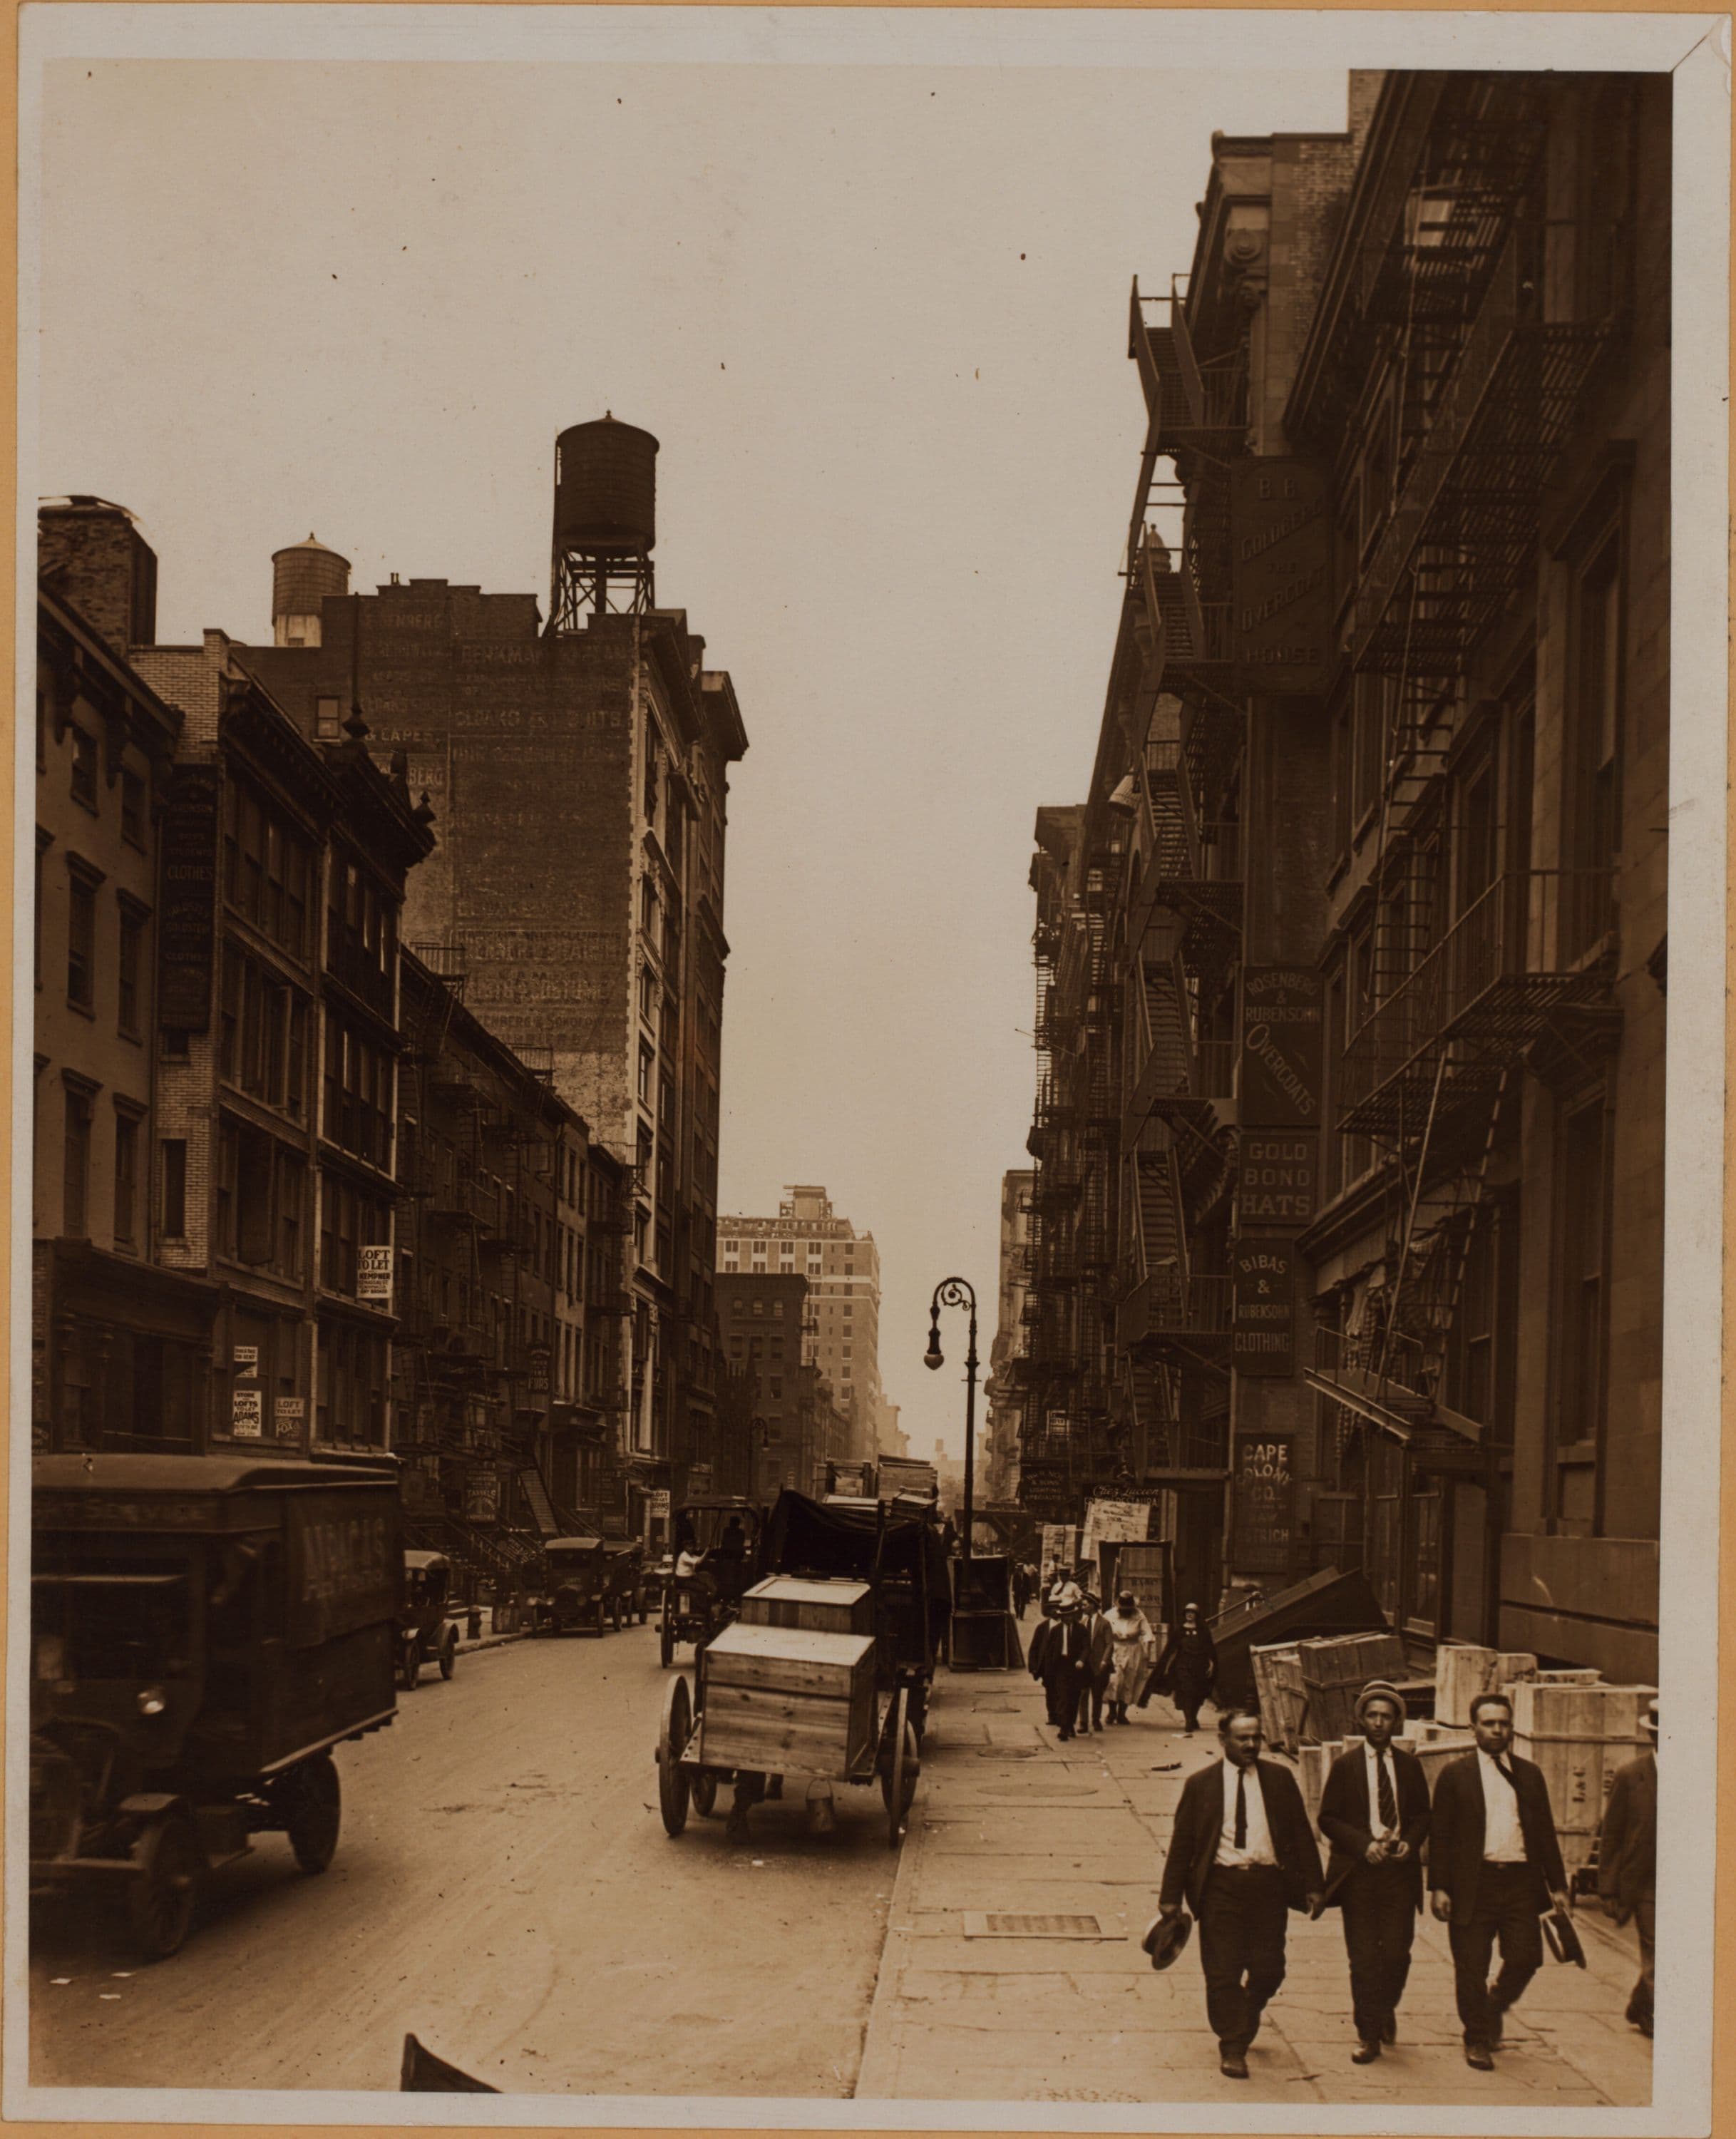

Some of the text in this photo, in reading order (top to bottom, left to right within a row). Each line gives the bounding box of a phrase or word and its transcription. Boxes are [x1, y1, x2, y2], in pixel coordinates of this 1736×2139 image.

[1246, 647, 1320, 665] HOUSE
[167, 864, 213, 881] CLOTHES
[1246, 973, 1319, 997] ROSENBERG
[1276, 990, 1288, 1005] &
[1246, 1024, 1318, 1115] OVERCOATS
[1249, 1142, 1308, 1160] GOLD
[1245, 1168, 1310, 1186] BOND
[1241, 1194, 1311, 1216] HATS
[358, 1249, 391, 1260] LOFT
[358, 1260, 390, 1271] TO LET
[1239, 1254, 1289, 1274] BIBAS
[1258, 1278, 1271, 1294] &
[1235, 1332, 1290, 1352] CLOTHING
[233, 1411, 260, 1425] ADAMS
[1243, 1444, 1288, 1461] CAPE
